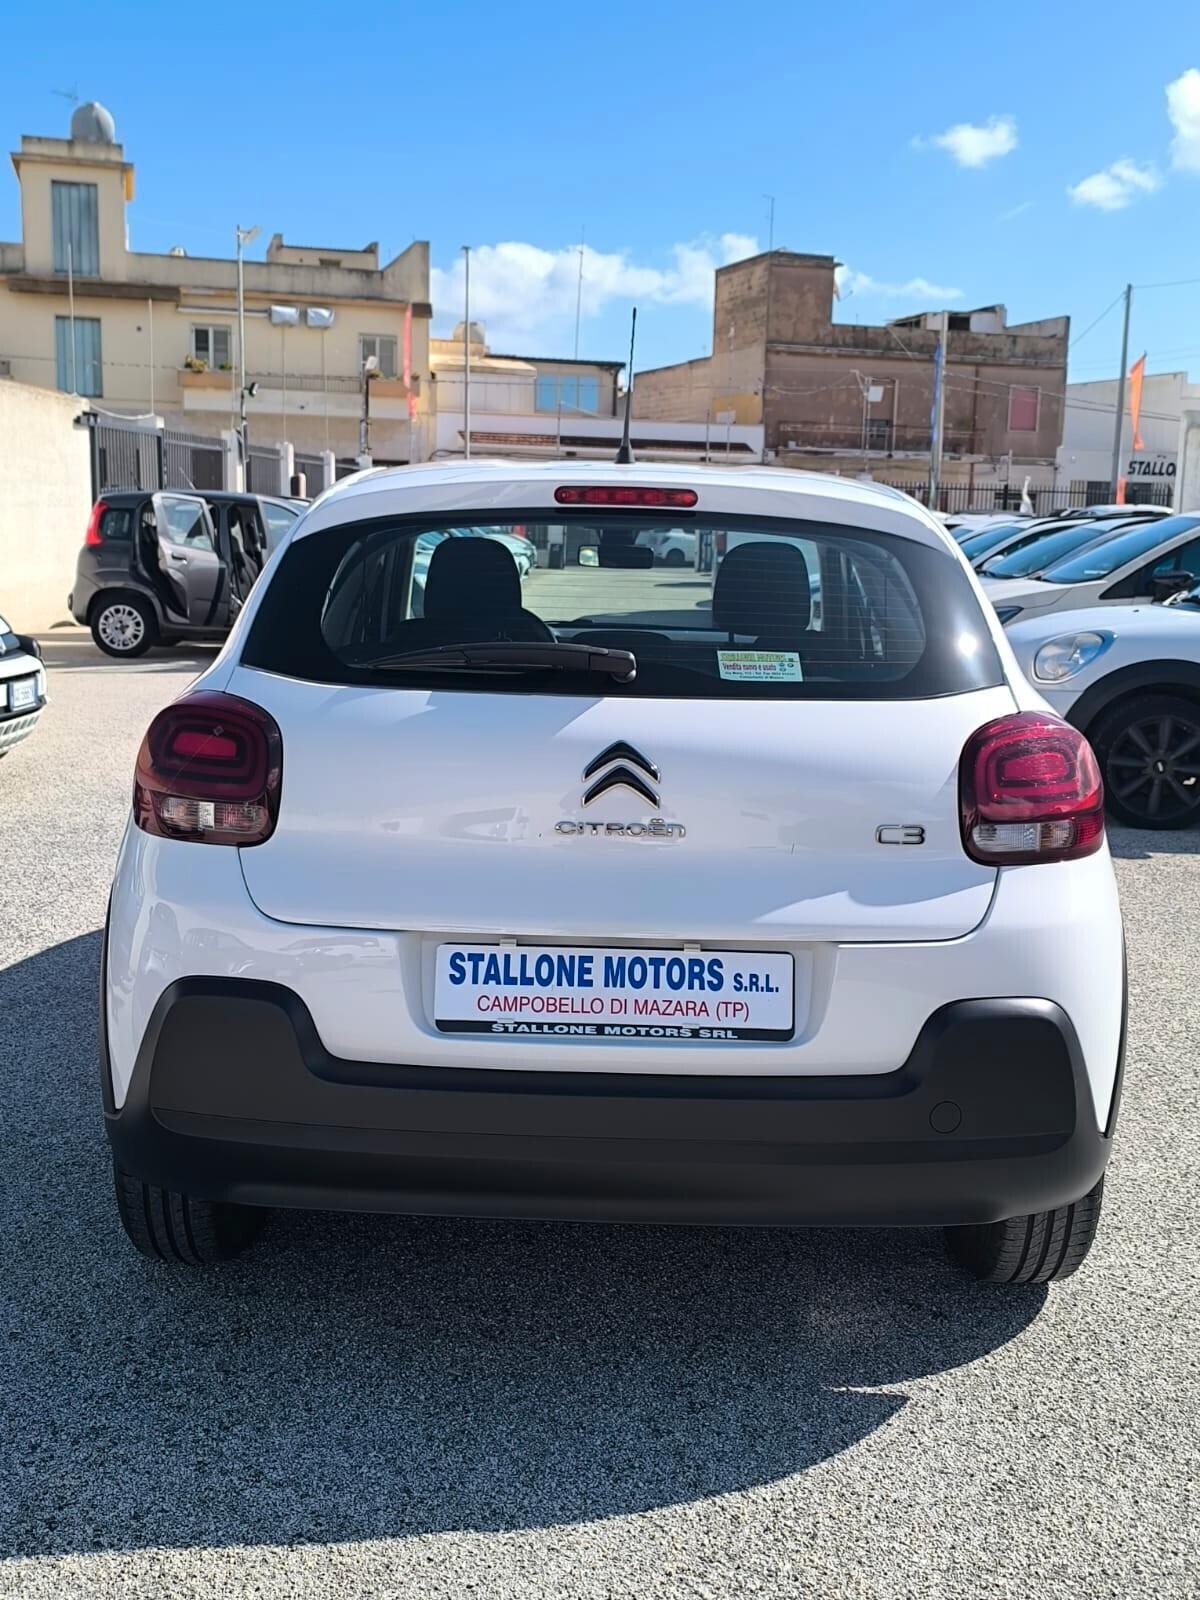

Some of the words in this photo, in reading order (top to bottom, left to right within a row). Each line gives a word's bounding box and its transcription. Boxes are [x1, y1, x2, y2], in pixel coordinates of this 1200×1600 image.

[1127, 460, 1177, 477] STALLO
[554, 818, 686, 838] CITROËN
[875, 824, 926, 845] C3
[449, 951, 594, 988] STALLONE
[604, 956, 724, 992] MOTORS
[733, 972, 779, 993] S.R.L.
[477, 994, 604, 1015] CAMPOBELLO
[610, 998, 627, 1015] DI
[634, 999, 709, 1017] MAZARA
[716, 1001, 749, 1022] (TP)
[491, 1023, 597, 1035] STALLONE
[604, 1026, 692, 1038] MOTORS
[699, 1029, 738, 1039] SRL
